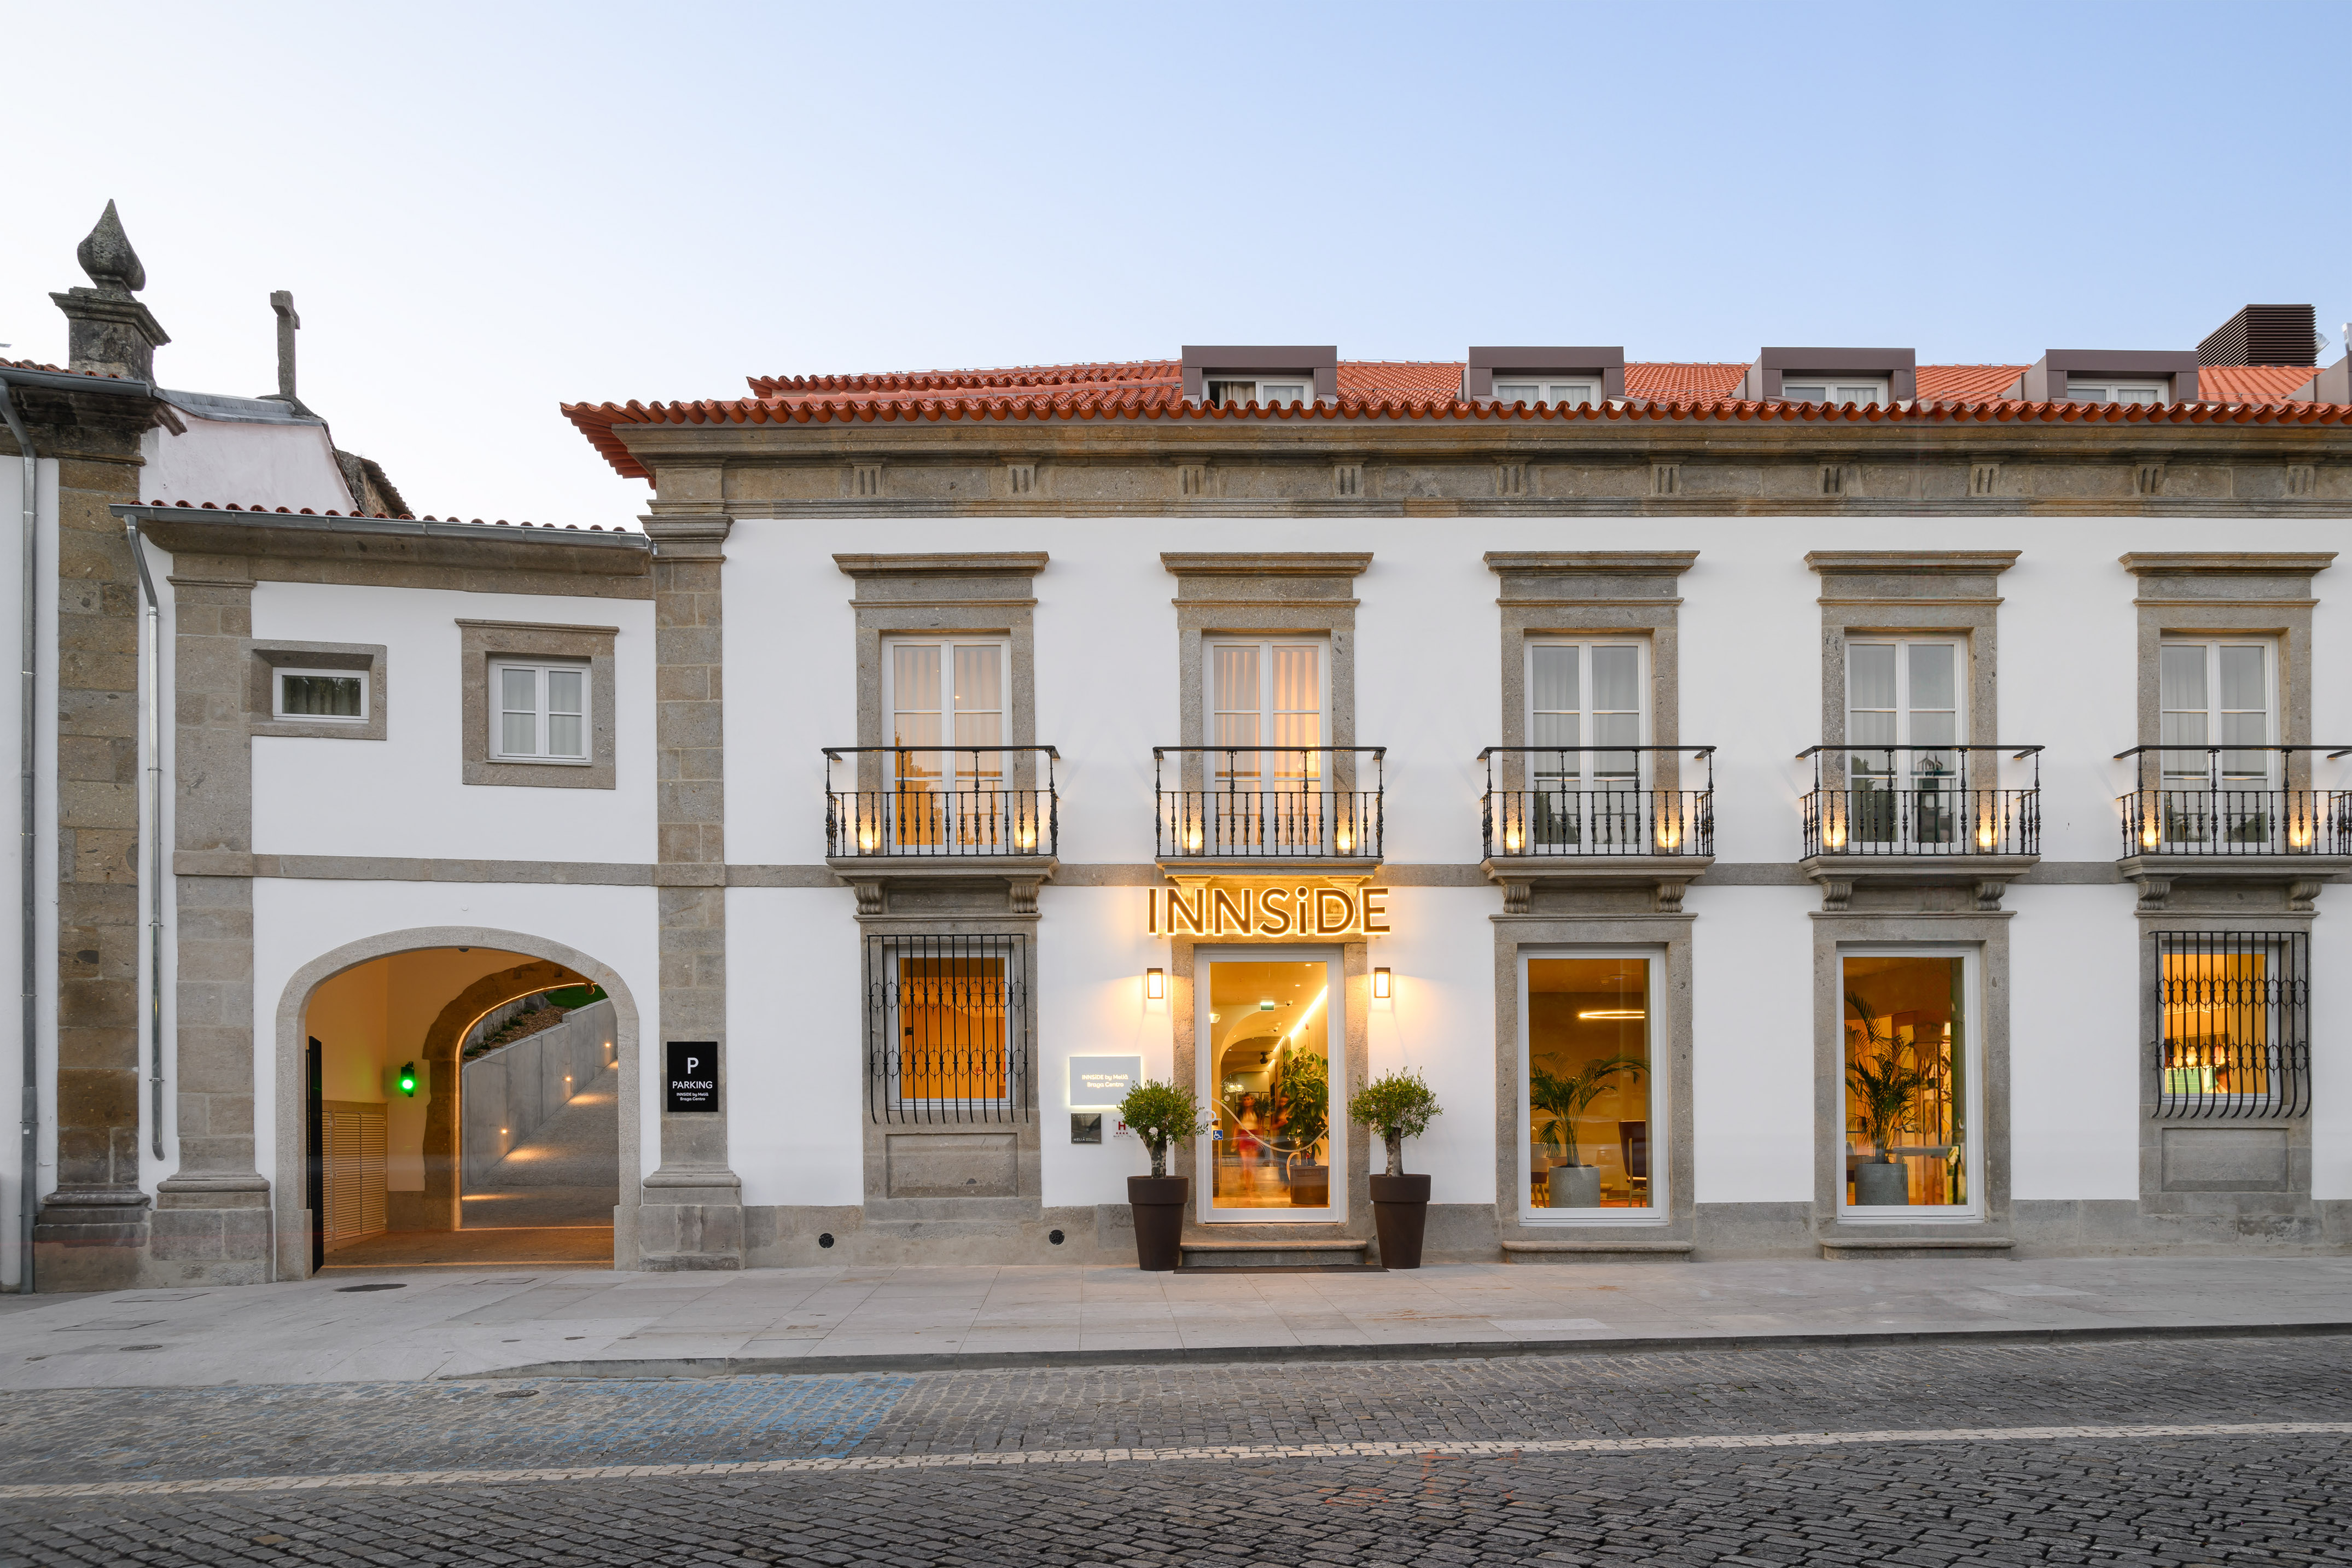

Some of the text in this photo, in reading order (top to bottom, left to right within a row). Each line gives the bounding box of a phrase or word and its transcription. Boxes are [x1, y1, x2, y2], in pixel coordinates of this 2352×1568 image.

[1148, 886, 1391, 937] INNSiDE
[688, 1057, 698, 1074] P
[672, 1081, 713, 1089] PARKING
[1118, 1121, 1126, 1130] H
